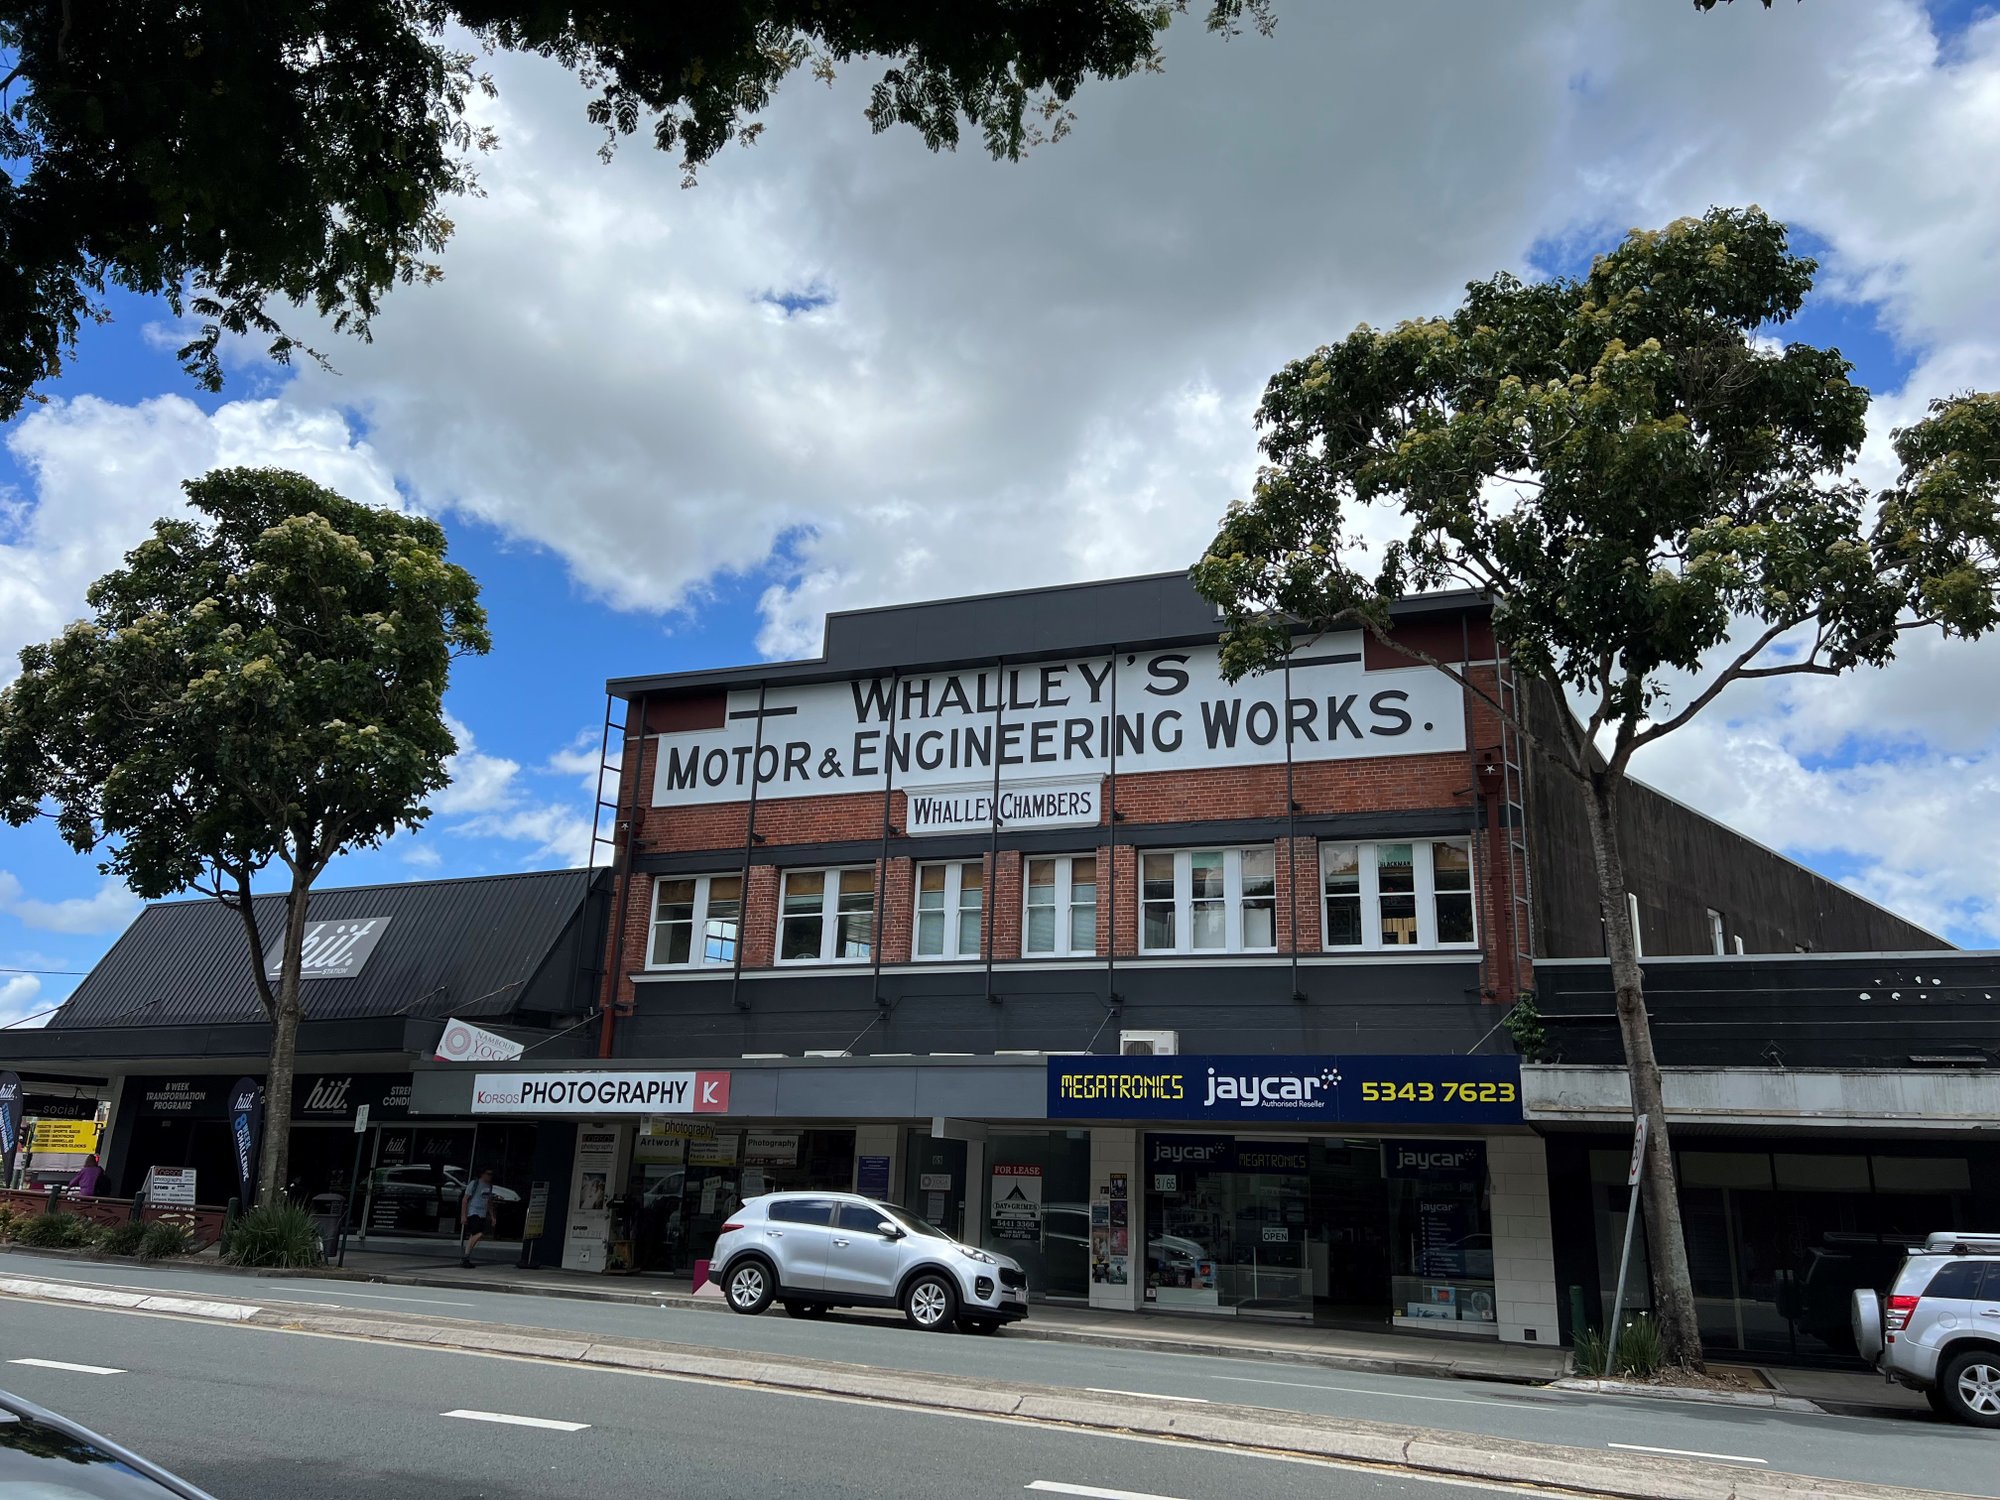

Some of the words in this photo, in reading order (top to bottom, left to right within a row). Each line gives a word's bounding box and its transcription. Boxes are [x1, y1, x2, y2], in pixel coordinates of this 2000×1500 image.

[850, 653, 1191, 723] WHALLEY'S
[666, 740, 812, 791] MOTOR
[817, 747, 844, 779] &
[852, 709, 1184, 777] ENGINEERING
[914, 793, 998, 825] WHALLEY
[999, 790, 1092, 820] CHAMBERS
[476, 1031, 516, 1052] NAMBOUR
[146, 1091, 206, 1101] TRANSFORMATION
[172, 1082, 190, 1091] WEEK
[520, 1080, 688, 1105] PHOTOGRAPHY
[702, 1080, 719, 1105] K
[1060, 1073, 1185, 1099] MEGATRONICS
[1204, 1067, 1322, 1108] jaycar
[1361, 1081, 1434, 1102] 5343
[1441, 1082, 1516, 1103] 7623
[153, 1101, 192, 1110] PROGRAMS
[1260, 1100, 1297, 1108] Authorised
[1299, 1100, 1325, 1108] Reseller
[665, 1119, 716, 1139] photography
[640, 1137, 681, 1148] Artwork
[747, 1138, 797, 1149] Photography
[1153, 1140, 1215, 1163] jaycar
[1238, 1153, 1307, 1168] MEGATRONICS
[1396, 1146, 1464, 1170] jaycar
[994, 1165, 1011, 1174] FOR
[1013, 1165, 1041, 1175] LEASE
[995, 1202, 1009, 1210] DAY
[1011, 1203, 1038, 1211] GRIMES
[1420, 1200, 1454, 1213] jaycar
[1263, 1233, 1288, 1241] OPEN
